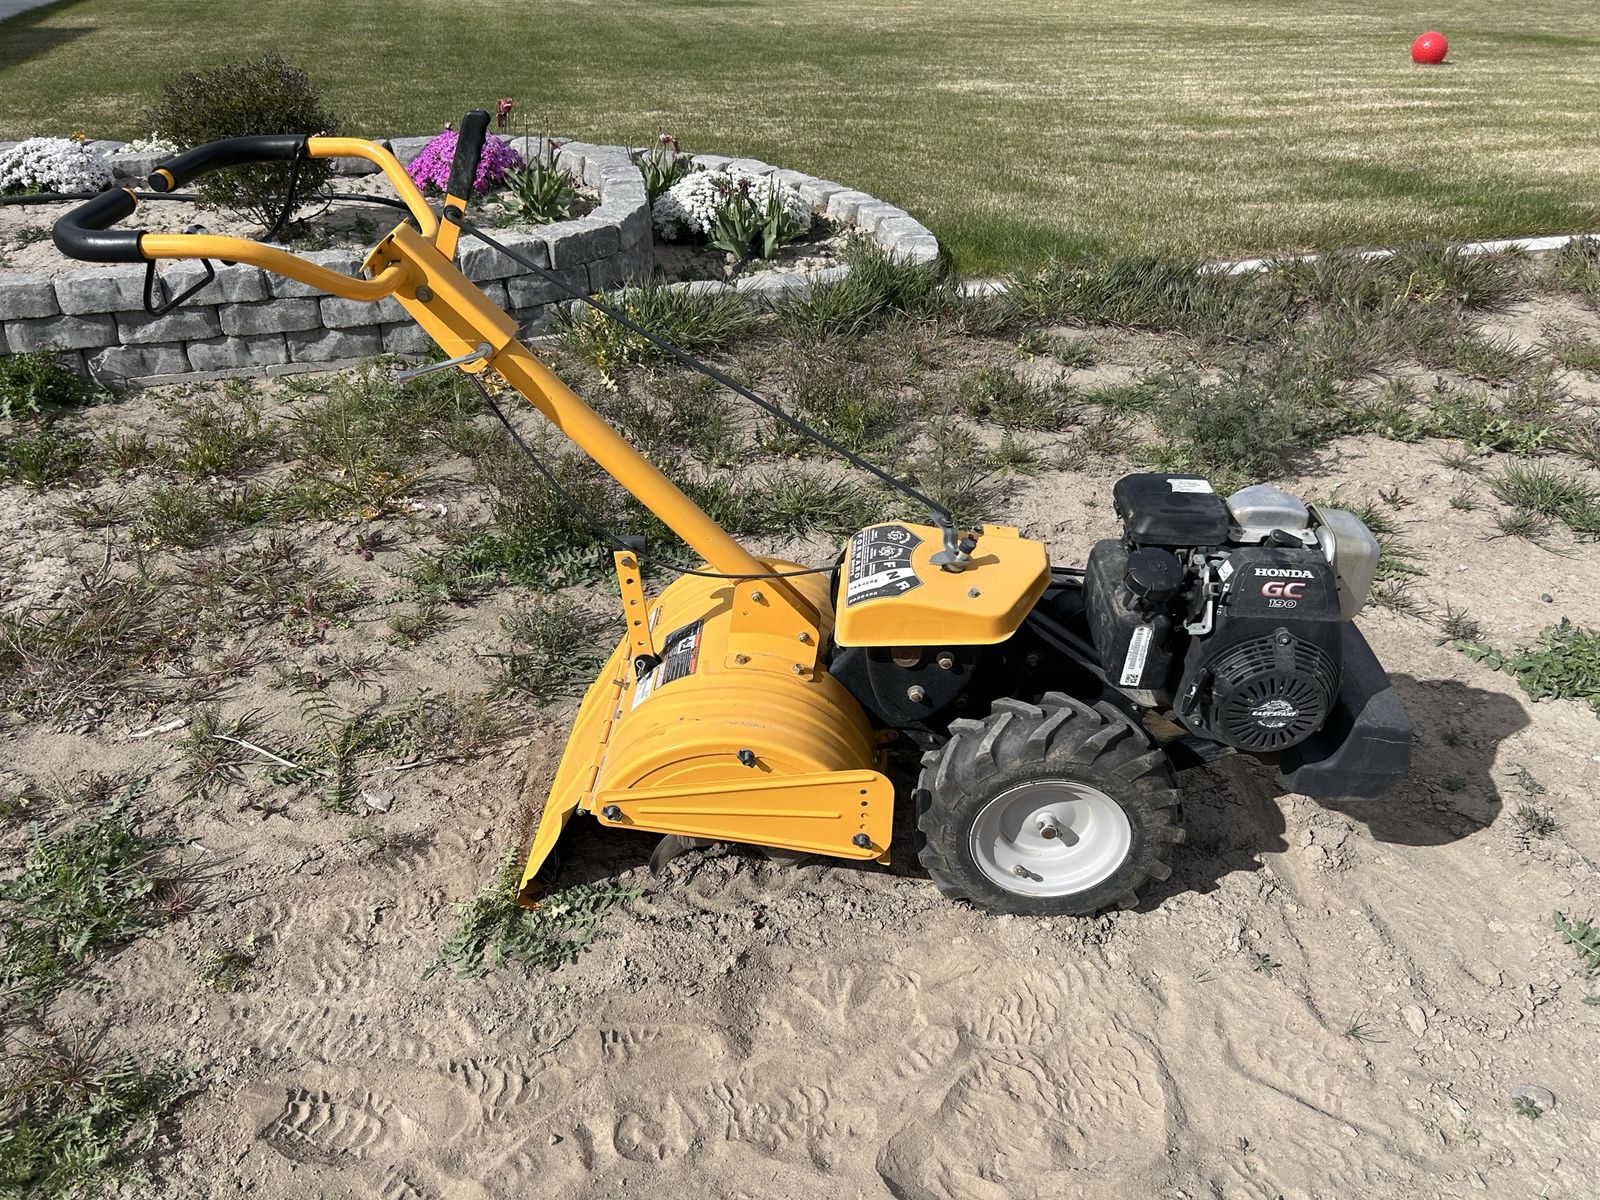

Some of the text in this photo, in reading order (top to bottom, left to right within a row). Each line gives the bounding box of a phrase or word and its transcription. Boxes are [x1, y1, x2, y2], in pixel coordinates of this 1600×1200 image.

[855, 533, 863, 578] FORWARD
[886, 570, 901, 580] N
[1254, 567, 1315, 579] HONDA
[895, 580, 911, 591] R
[1261, 581, 1306, 599] GC
[1268, 599, 1297, 609] 190
